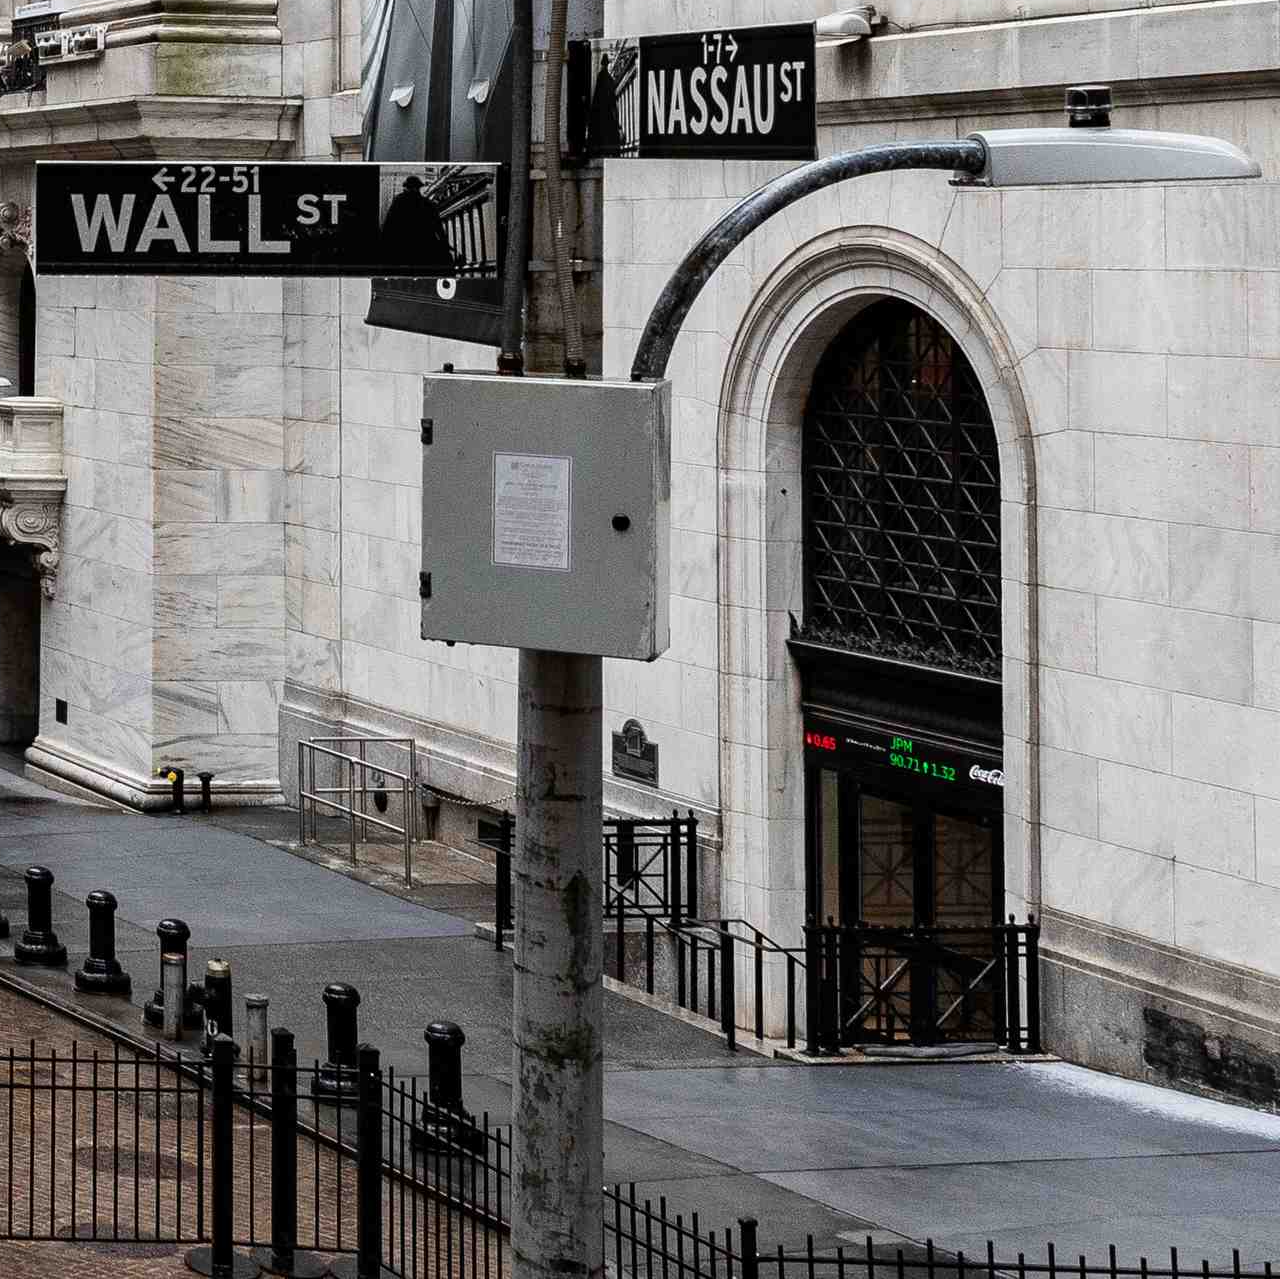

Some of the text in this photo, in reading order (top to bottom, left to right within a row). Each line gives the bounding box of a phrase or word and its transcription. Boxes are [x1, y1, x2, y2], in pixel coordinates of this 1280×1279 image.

[647, 61, 805, 135] NASSAU ST
[181, 166, 260, 193] 22-51
[70, 193, 347, 253] WALL ST
[890, 735, 913, 754] JPM
[889, 753, 956, 782] 90.71 1.32
